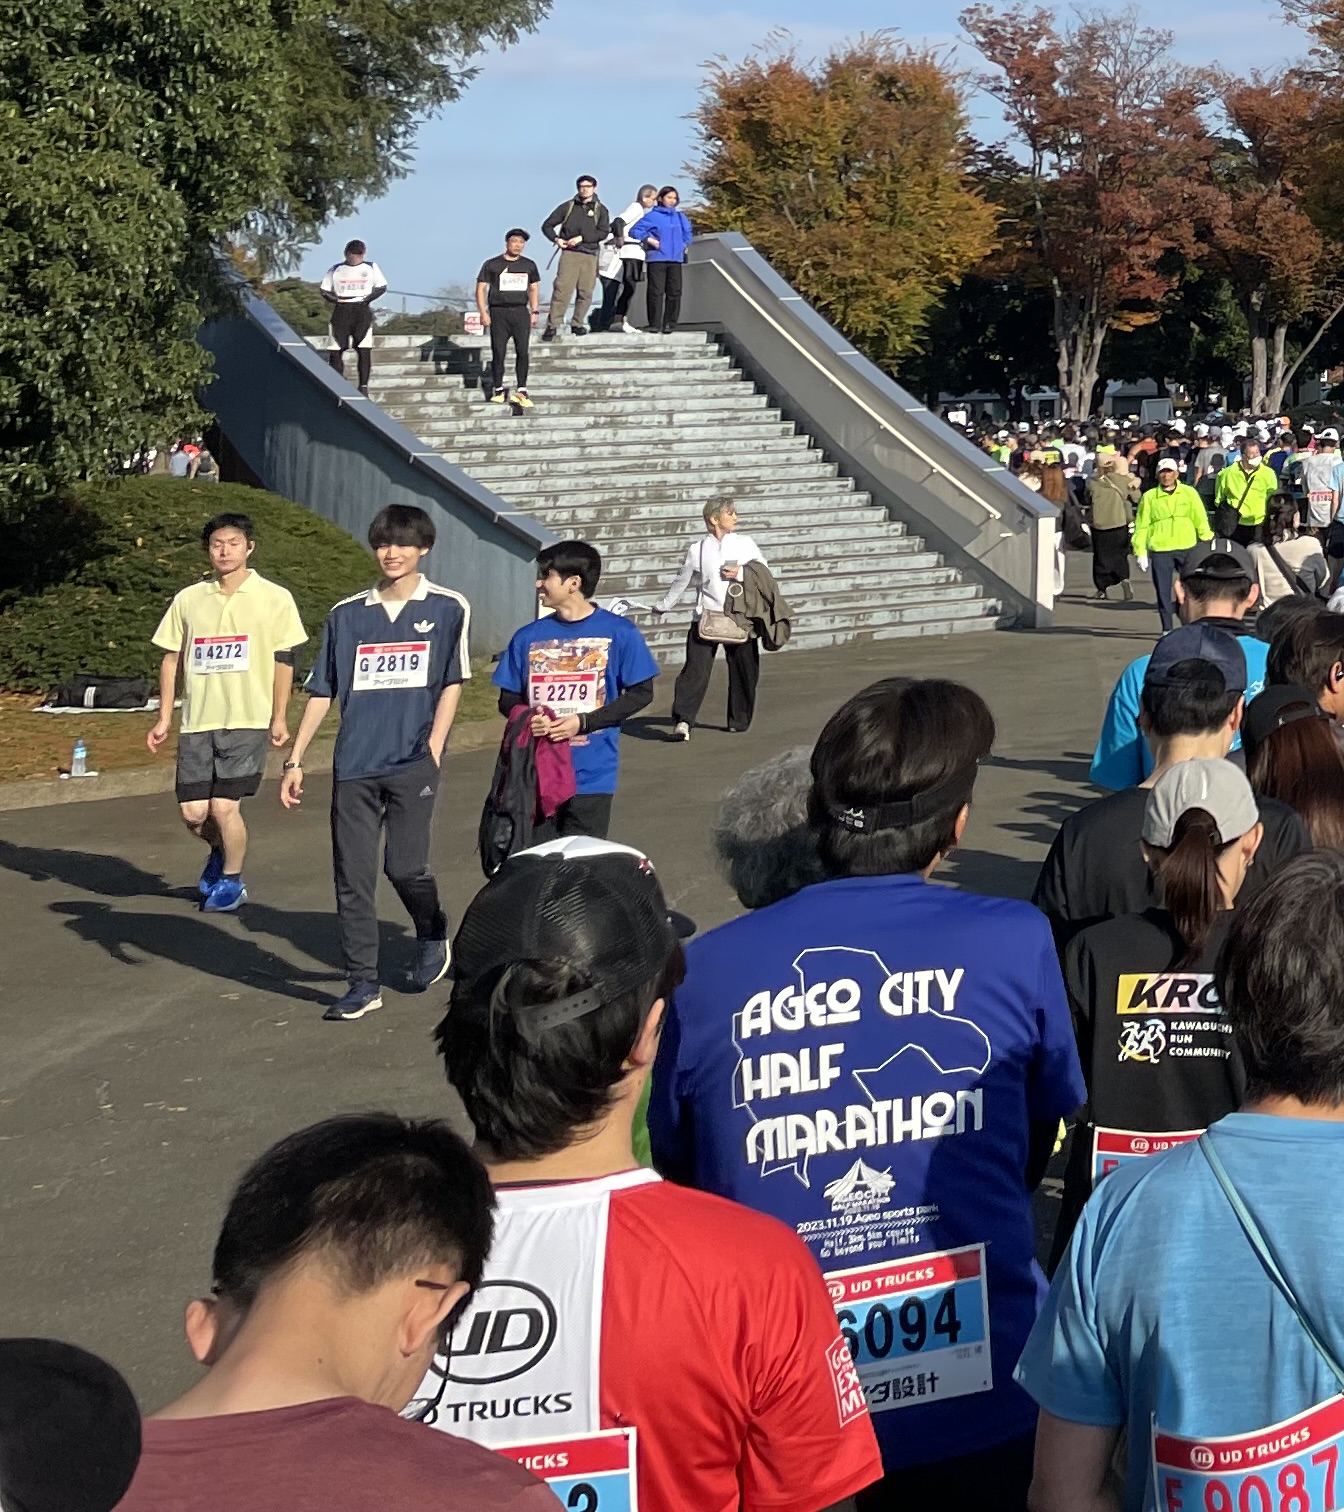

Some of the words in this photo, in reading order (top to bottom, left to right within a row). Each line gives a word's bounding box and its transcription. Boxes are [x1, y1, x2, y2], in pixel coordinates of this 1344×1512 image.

[206, 644, 242, 659] 4272
[360, 658, 369, 672] G
[375, 654, 419, 672] 2819
[533, 686, 540, 700] E
[547, 684, 588, 701] 2279
[742, 978, 861, 1039] AGEO
[879, 968, 965, 1017] CITY
[1170, 1035, 1193, 1043] RUN
[1169, 1047, 1231, 1060] COMMUNITY
[742, 1042, 845, 1101] HALF
[746, 1088, 983, 1164] MARATHON
[882, 1206, 914, 1220] sports
[851, 1280, 871, 1294] UD
[875, 1267, 935, 1290] TRUCKS
[838, 1288, 962, 1361] 6094
[446, 1392, 573, 1423] TRUCKS
[1219, 1448, 1242, 1465] UD
[1246, 1426, 1311, 1458] TRUCKS
